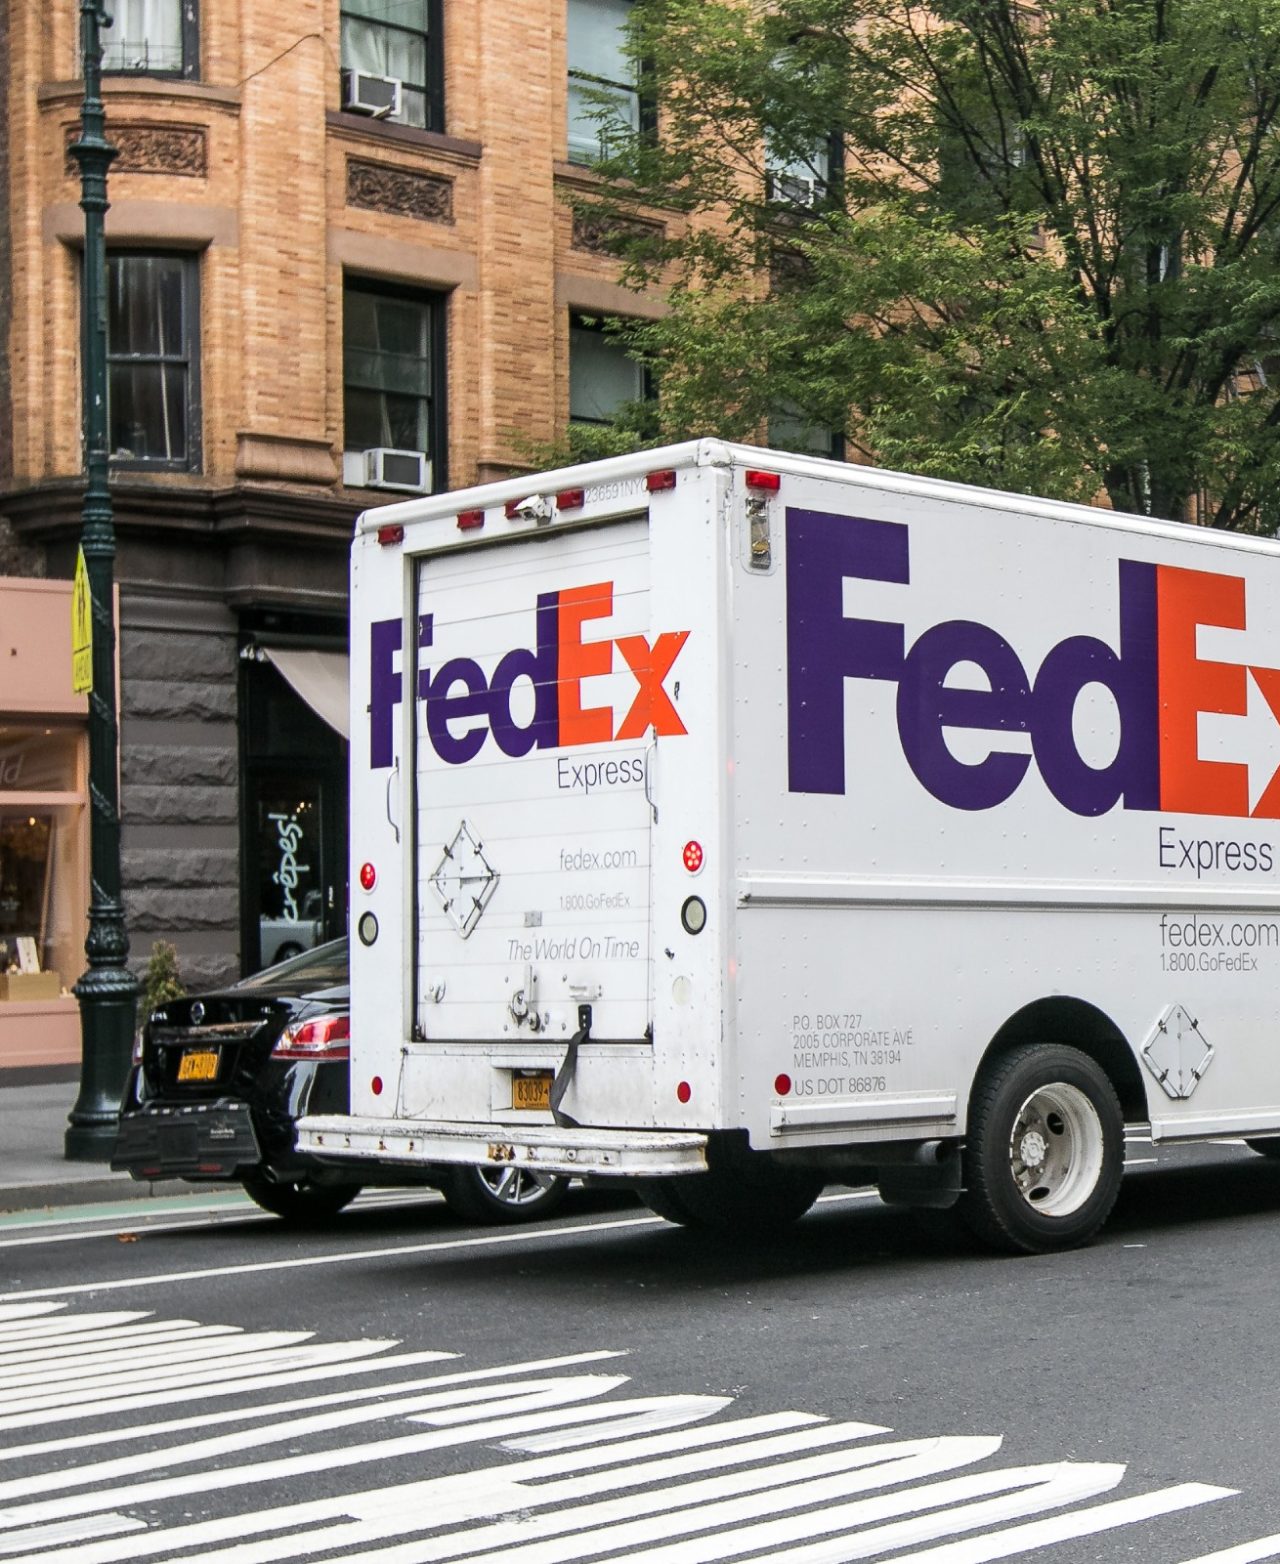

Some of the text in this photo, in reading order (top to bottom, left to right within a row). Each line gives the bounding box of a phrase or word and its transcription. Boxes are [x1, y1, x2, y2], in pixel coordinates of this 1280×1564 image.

[371, 581, 691, 769] FedEx
[557, 757, 644, 794] Express
[560, 848, 637, 871] fedex.com
[1159, 827, 1273, 879] Express
[267, 812, 310, 924] crêpes!
[560, 892, 631, 911] 1.800.GoFedEx
[1159, 913, 1279, 947] fedex.com
[508, 936, 640, 960] The World On Time
[1160, 952, 1258, 972] 1.800.GoFedEx
[816, 1015, 840, 1030] BOX
[844, 1014, 863, 1029] 727
[793, 1034, 820, 1050] 2005
[822, 1031, 890, 1049] CORPORATE
[793, 1050, 902, 1069] MEMPHIS, TN 38194
[794, 1076, 887, 1096] US DOT 86876
